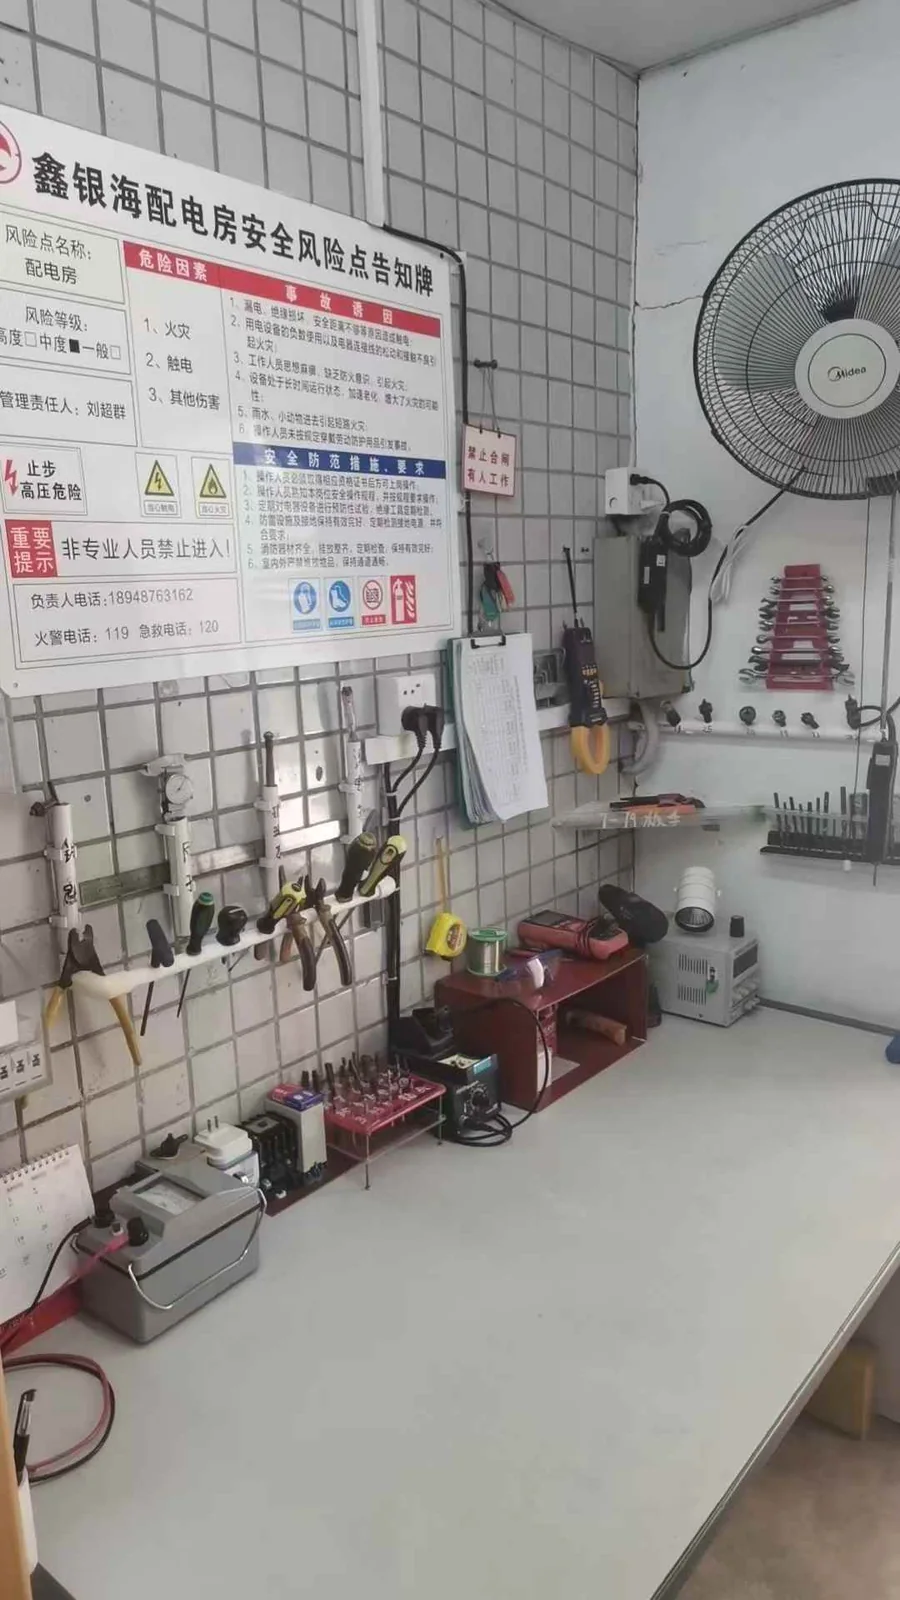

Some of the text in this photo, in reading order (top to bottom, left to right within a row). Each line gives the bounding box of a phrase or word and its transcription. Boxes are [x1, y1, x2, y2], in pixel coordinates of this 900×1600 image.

[32, 151, 434, 297] 鑫银海配电房安全风险点告知牌
[25, 257, 77, 285] 配电房
[138, 248, 208, 282] 危险因素
[285, 284, 393, 326] 事故诱因
[143, 317, 191, 341] 1、火灾
[145, 352, 193, 375] 2、触电
[828, 366, 867, 382] Midea
[149, 386, 220, 412] 3、其他伤害
[27, 459, 57, 477] 止步
[264, 449, 425, 475] 安全防范措施、要求
[467, 445, 510, 467] 禁止合闸
[467, 466, 510, 488] 有人工作
[20, 481, 83, 501] 高压危险
[11, 526, 52, 550] 重要
[14, 552, 54, 574] 提示
